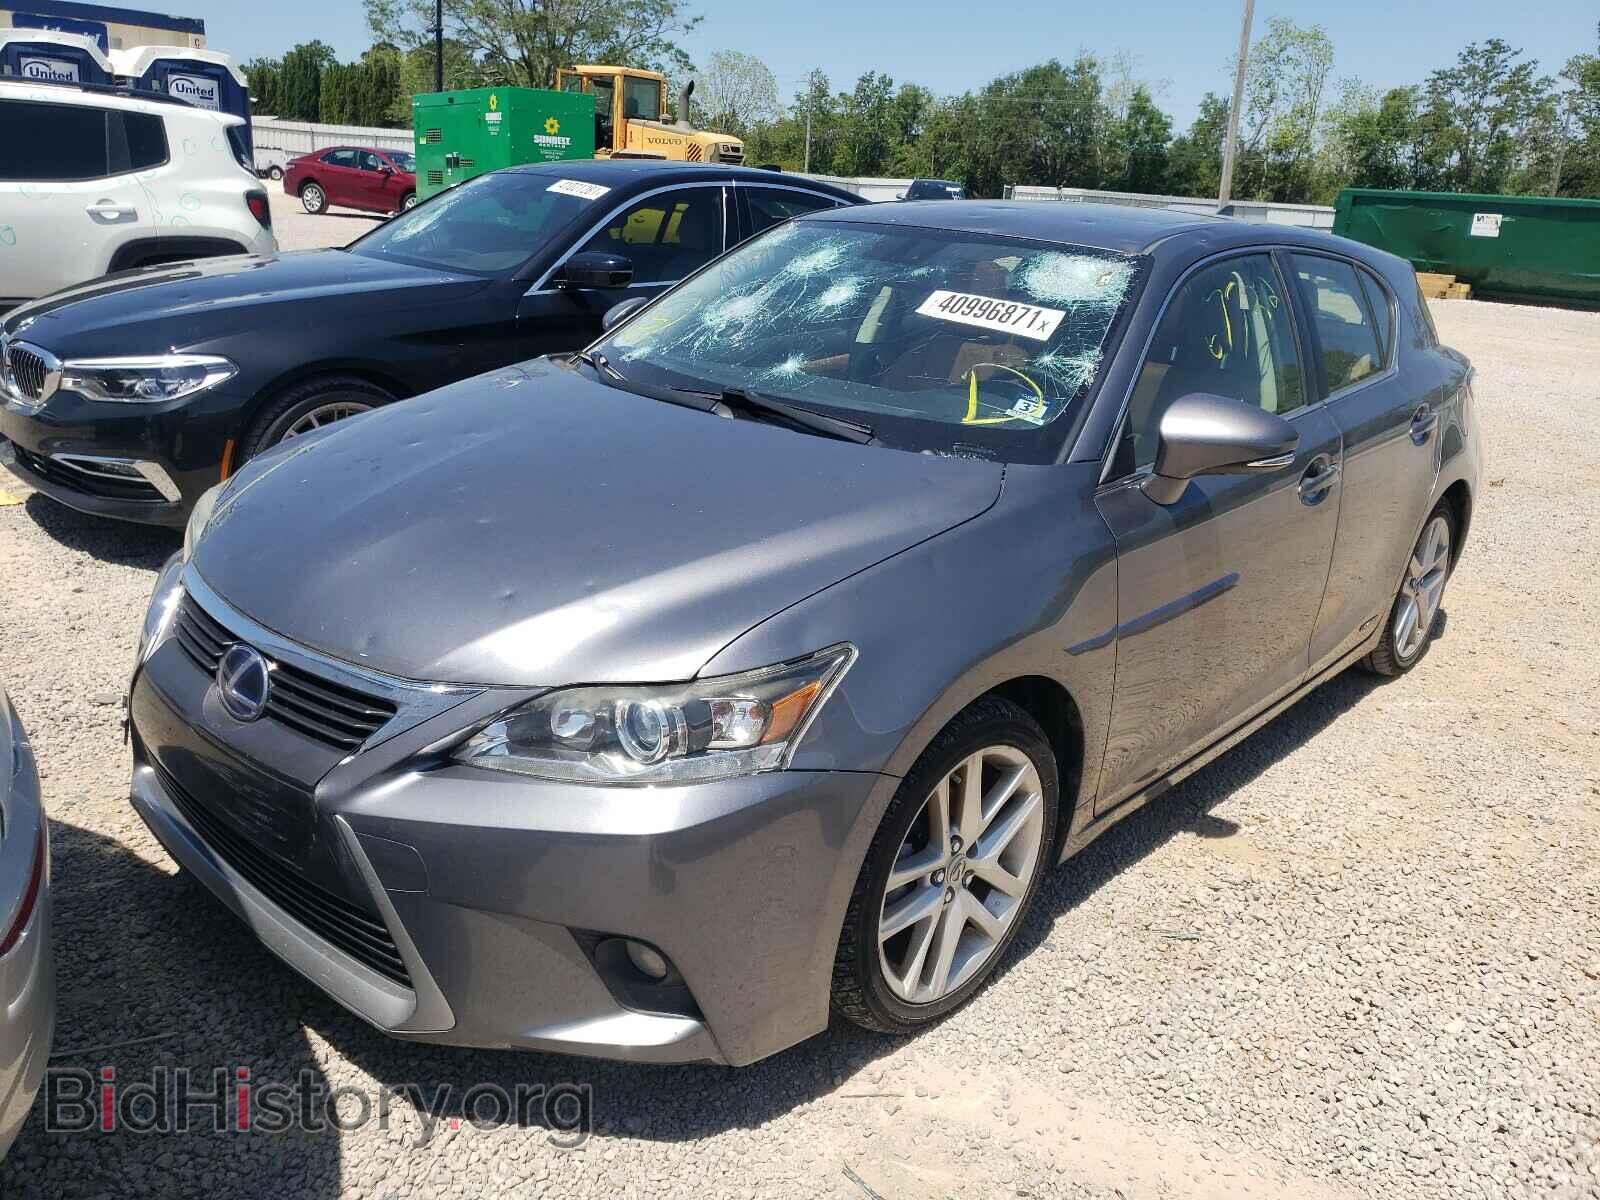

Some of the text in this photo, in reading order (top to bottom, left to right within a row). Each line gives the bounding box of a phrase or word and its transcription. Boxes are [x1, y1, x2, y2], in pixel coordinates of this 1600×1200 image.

[29, 66, 73, 81] United
[175, 82, 214, 97] United
[647, 137, 682, 145] VOLVO
